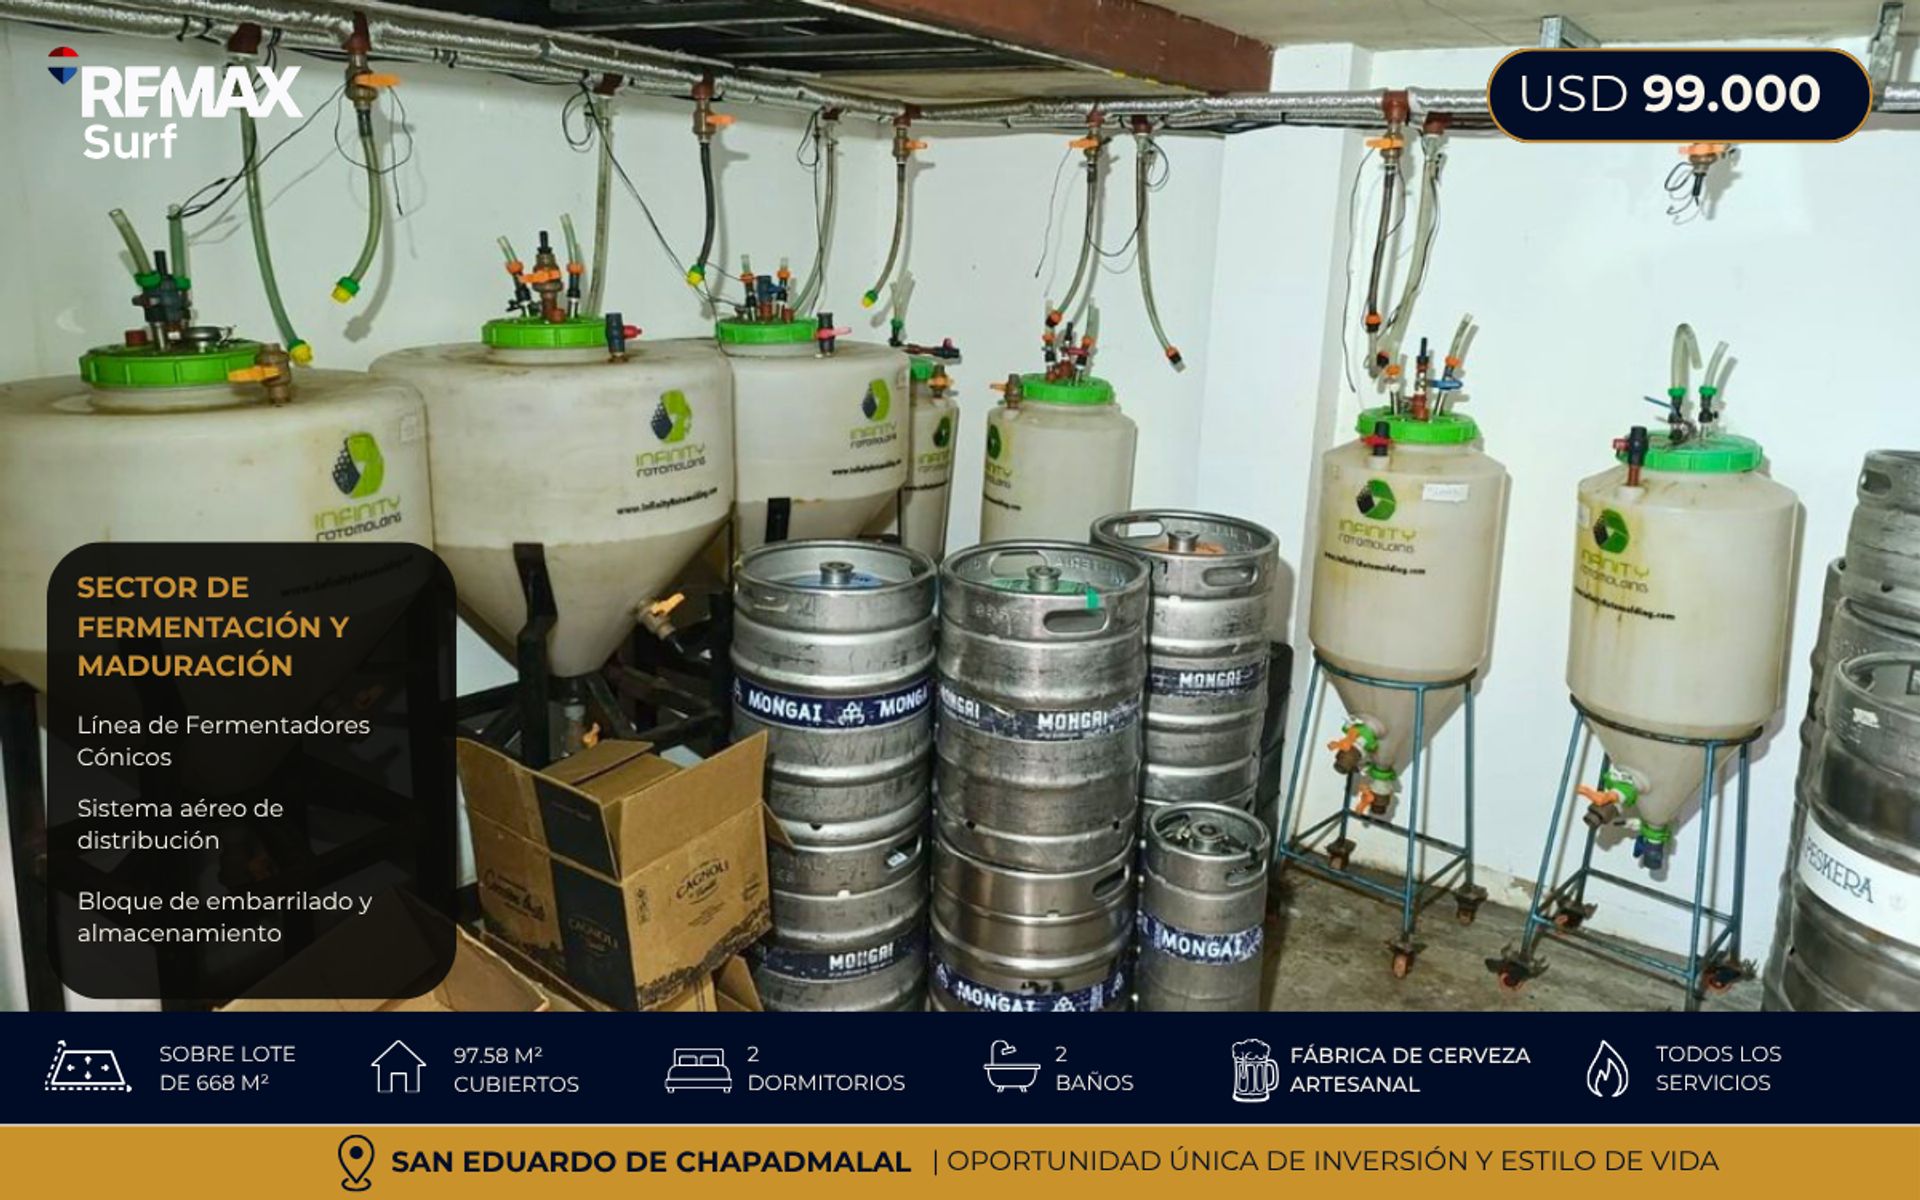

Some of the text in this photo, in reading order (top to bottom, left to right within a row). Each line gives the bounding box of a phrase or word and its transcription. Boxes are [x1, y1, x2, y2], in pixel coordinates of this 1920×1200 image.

[748, 689, 824, 722] MONGAI
[1037, 710, 1109, 732] MONGAI
[828, 941, 895, 971] MONGAI
[1161, 928, 1244, 958] MONGAI
